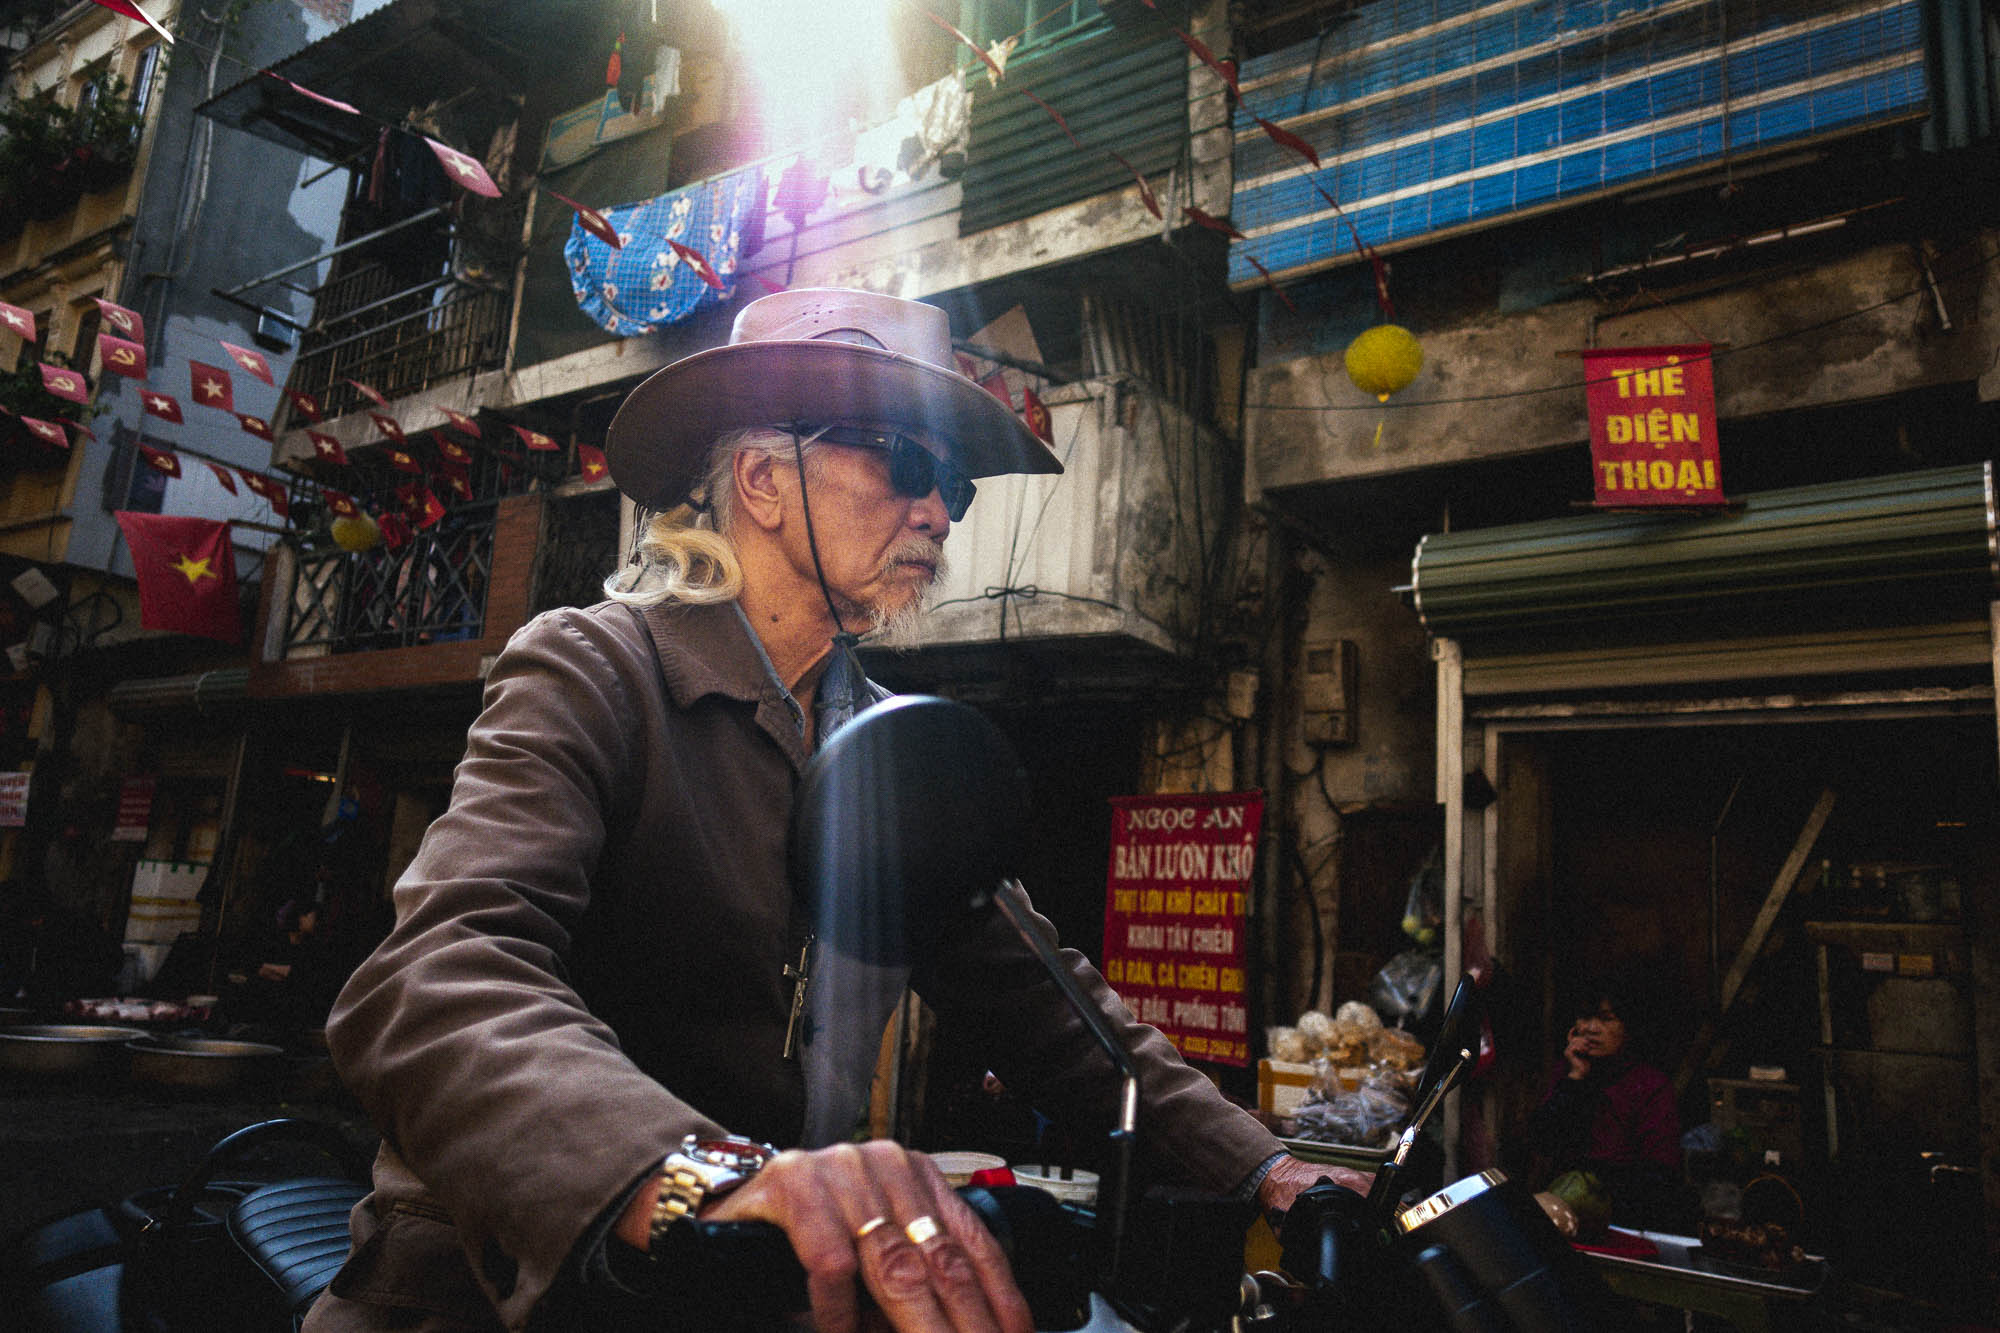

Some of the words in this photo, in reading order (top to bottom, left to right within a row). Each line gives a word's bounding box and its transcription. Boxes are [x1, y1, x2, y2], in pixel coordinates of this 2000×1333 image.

[1611, 355, 1685, 398] THẺ
[1606, 408, 1700, 449] ĐIỆN
[1600, 459, 1717, 495] THOẠI
[1127, 807, 1195, 834] NGỌC
[1202, 806, 1244, 830] AN
[1114, 835, 1151, 880] BÁN
[1212, 832, 1255, 881] KHÔ
